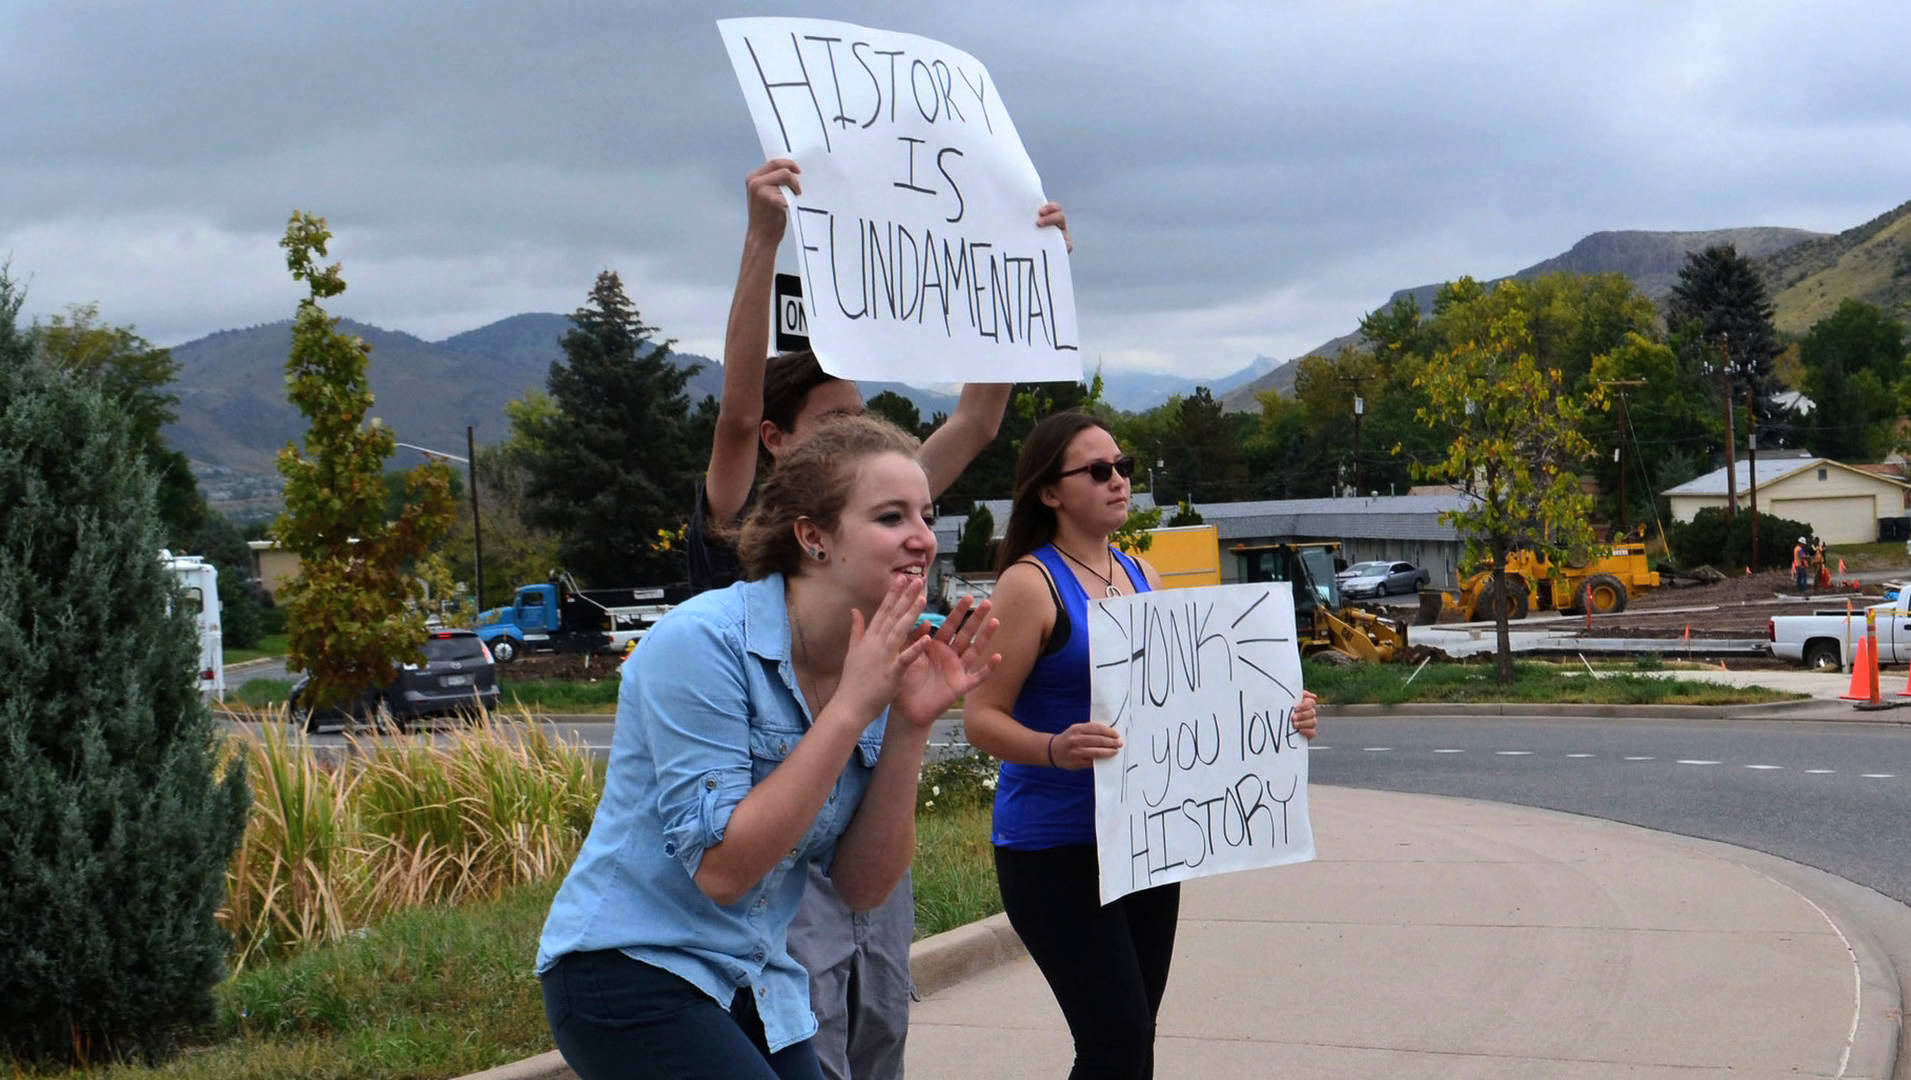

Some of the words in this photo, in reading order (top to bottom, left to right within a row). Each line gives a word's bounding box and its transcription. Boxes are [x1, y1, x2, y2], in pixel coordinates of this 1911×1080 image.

[743, 32, 994, 153] HISTORY
[893, 136, 965, 223] IS
[797, 206, 1079, 351] FUNDAMENTAL
[1128, 601, 1233, 708] HONK
[1142, 712, 1220, 808] you
[1239, 689, 1299, 762] love
[1129, 772, 1298, 890] HISTORY
